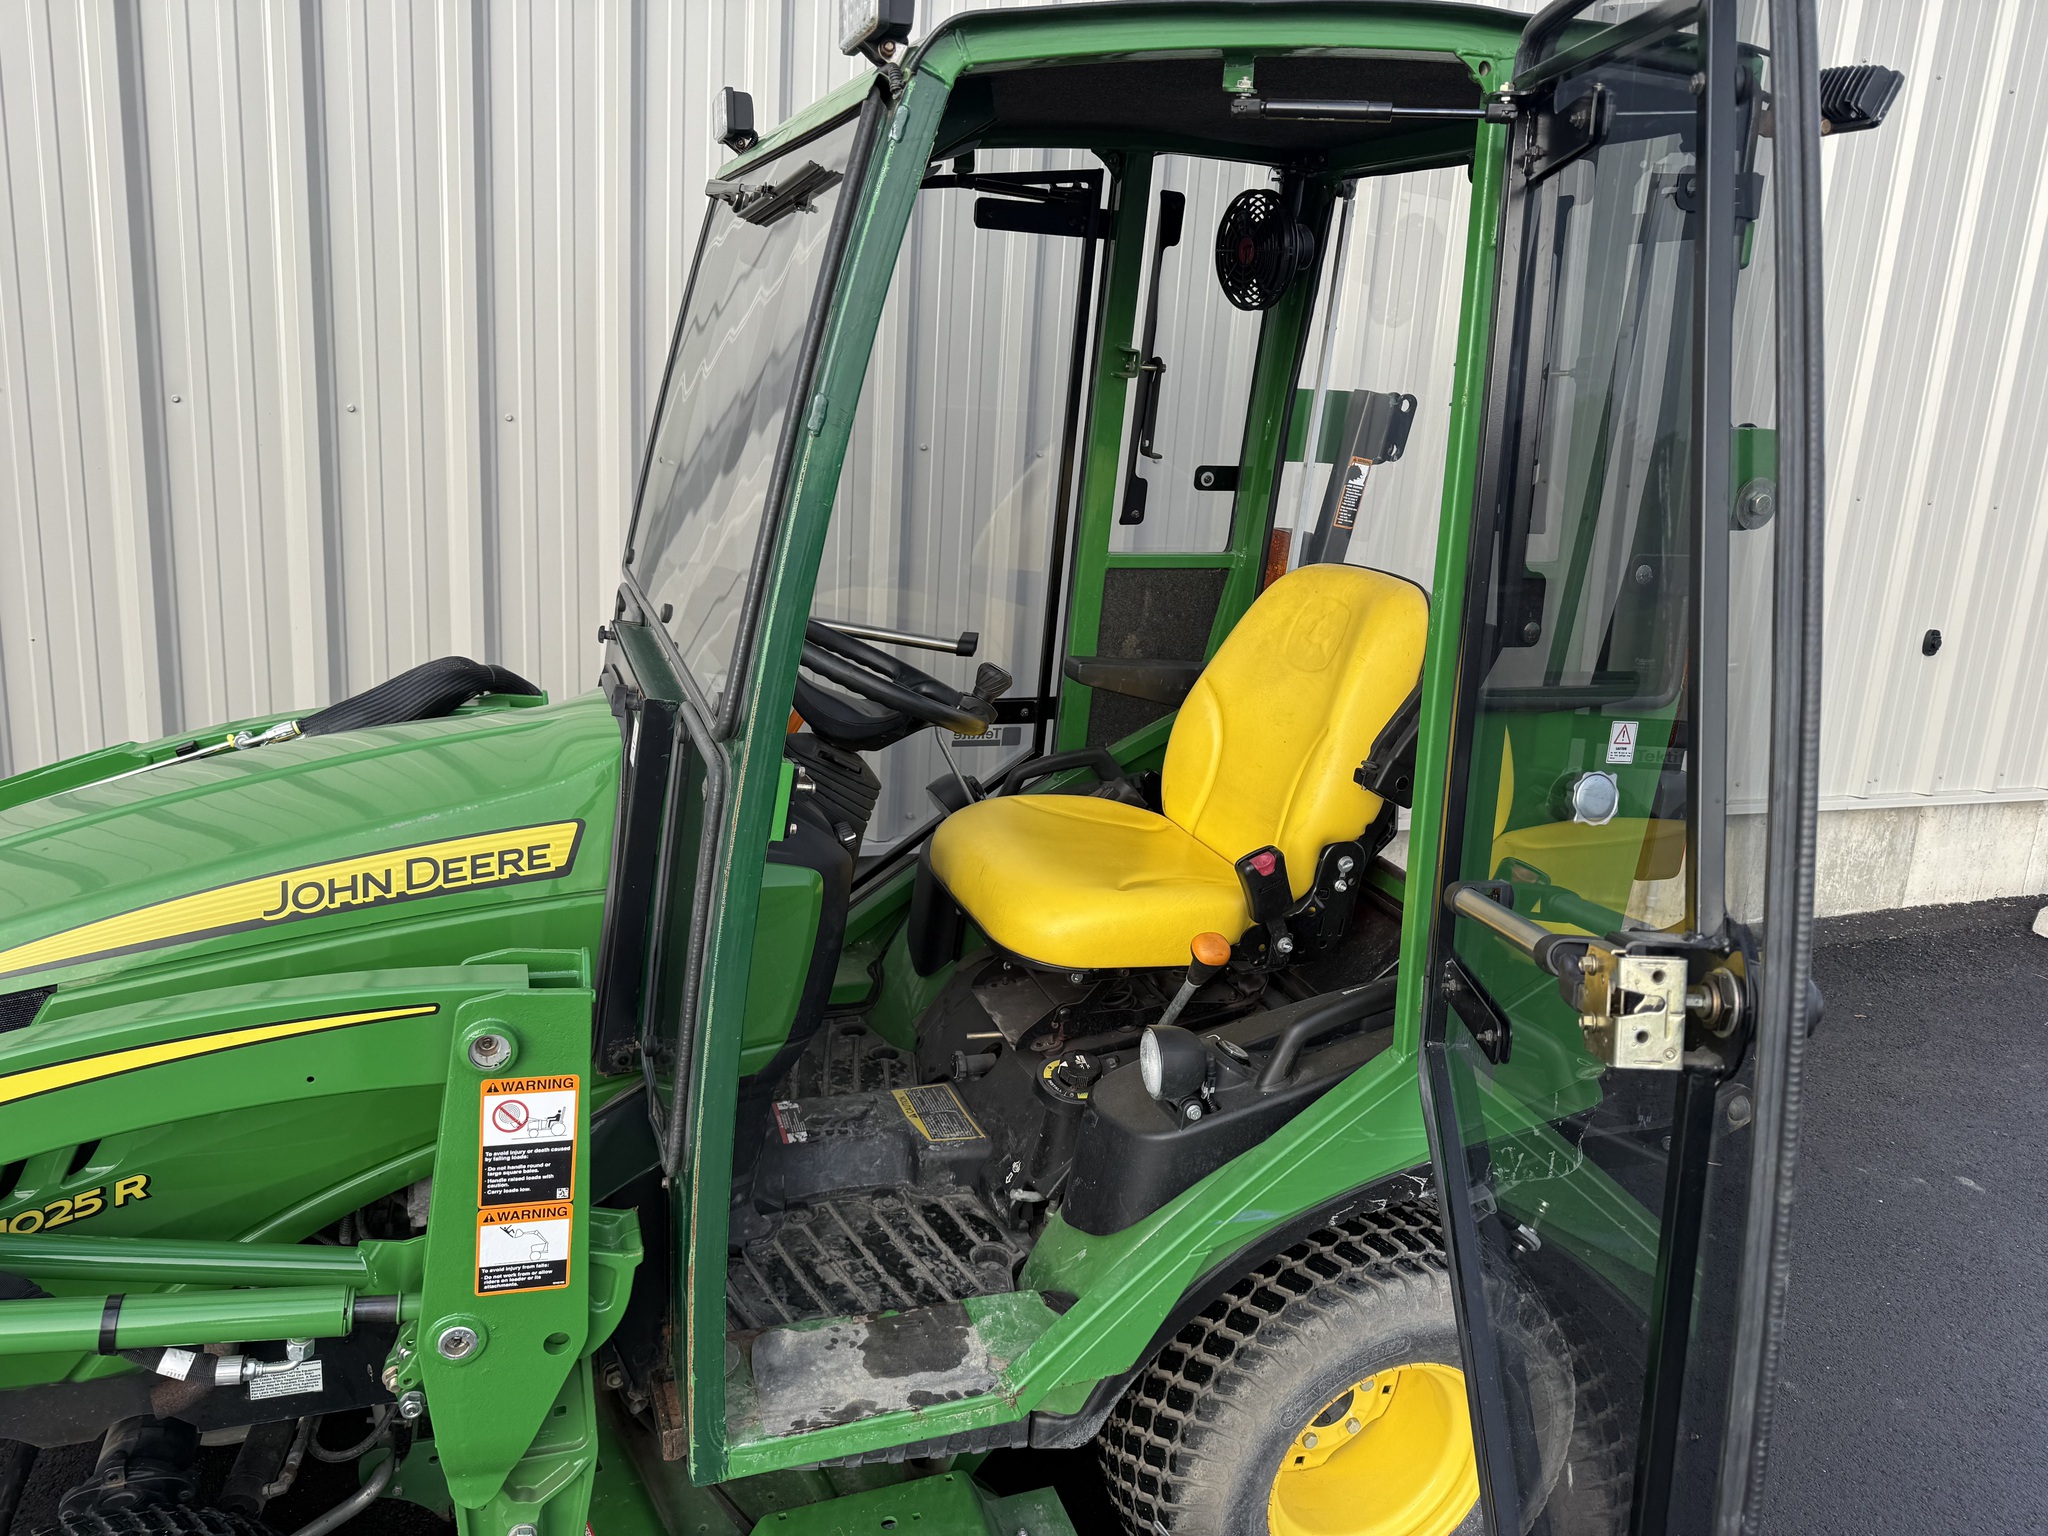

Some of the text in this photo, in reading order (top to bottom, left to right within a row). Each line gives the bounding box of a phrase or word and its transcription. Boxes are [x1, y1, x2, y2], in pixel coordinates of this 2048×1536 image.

[263, 843, 551, 918] JOHN DEERE
[501, 1077, 574, 1092] WARNING
[510, 1149, 526, 1157] injury
[114, 1174, 152, 1208] R
[497, 1206, 568, 1222] WARNING
